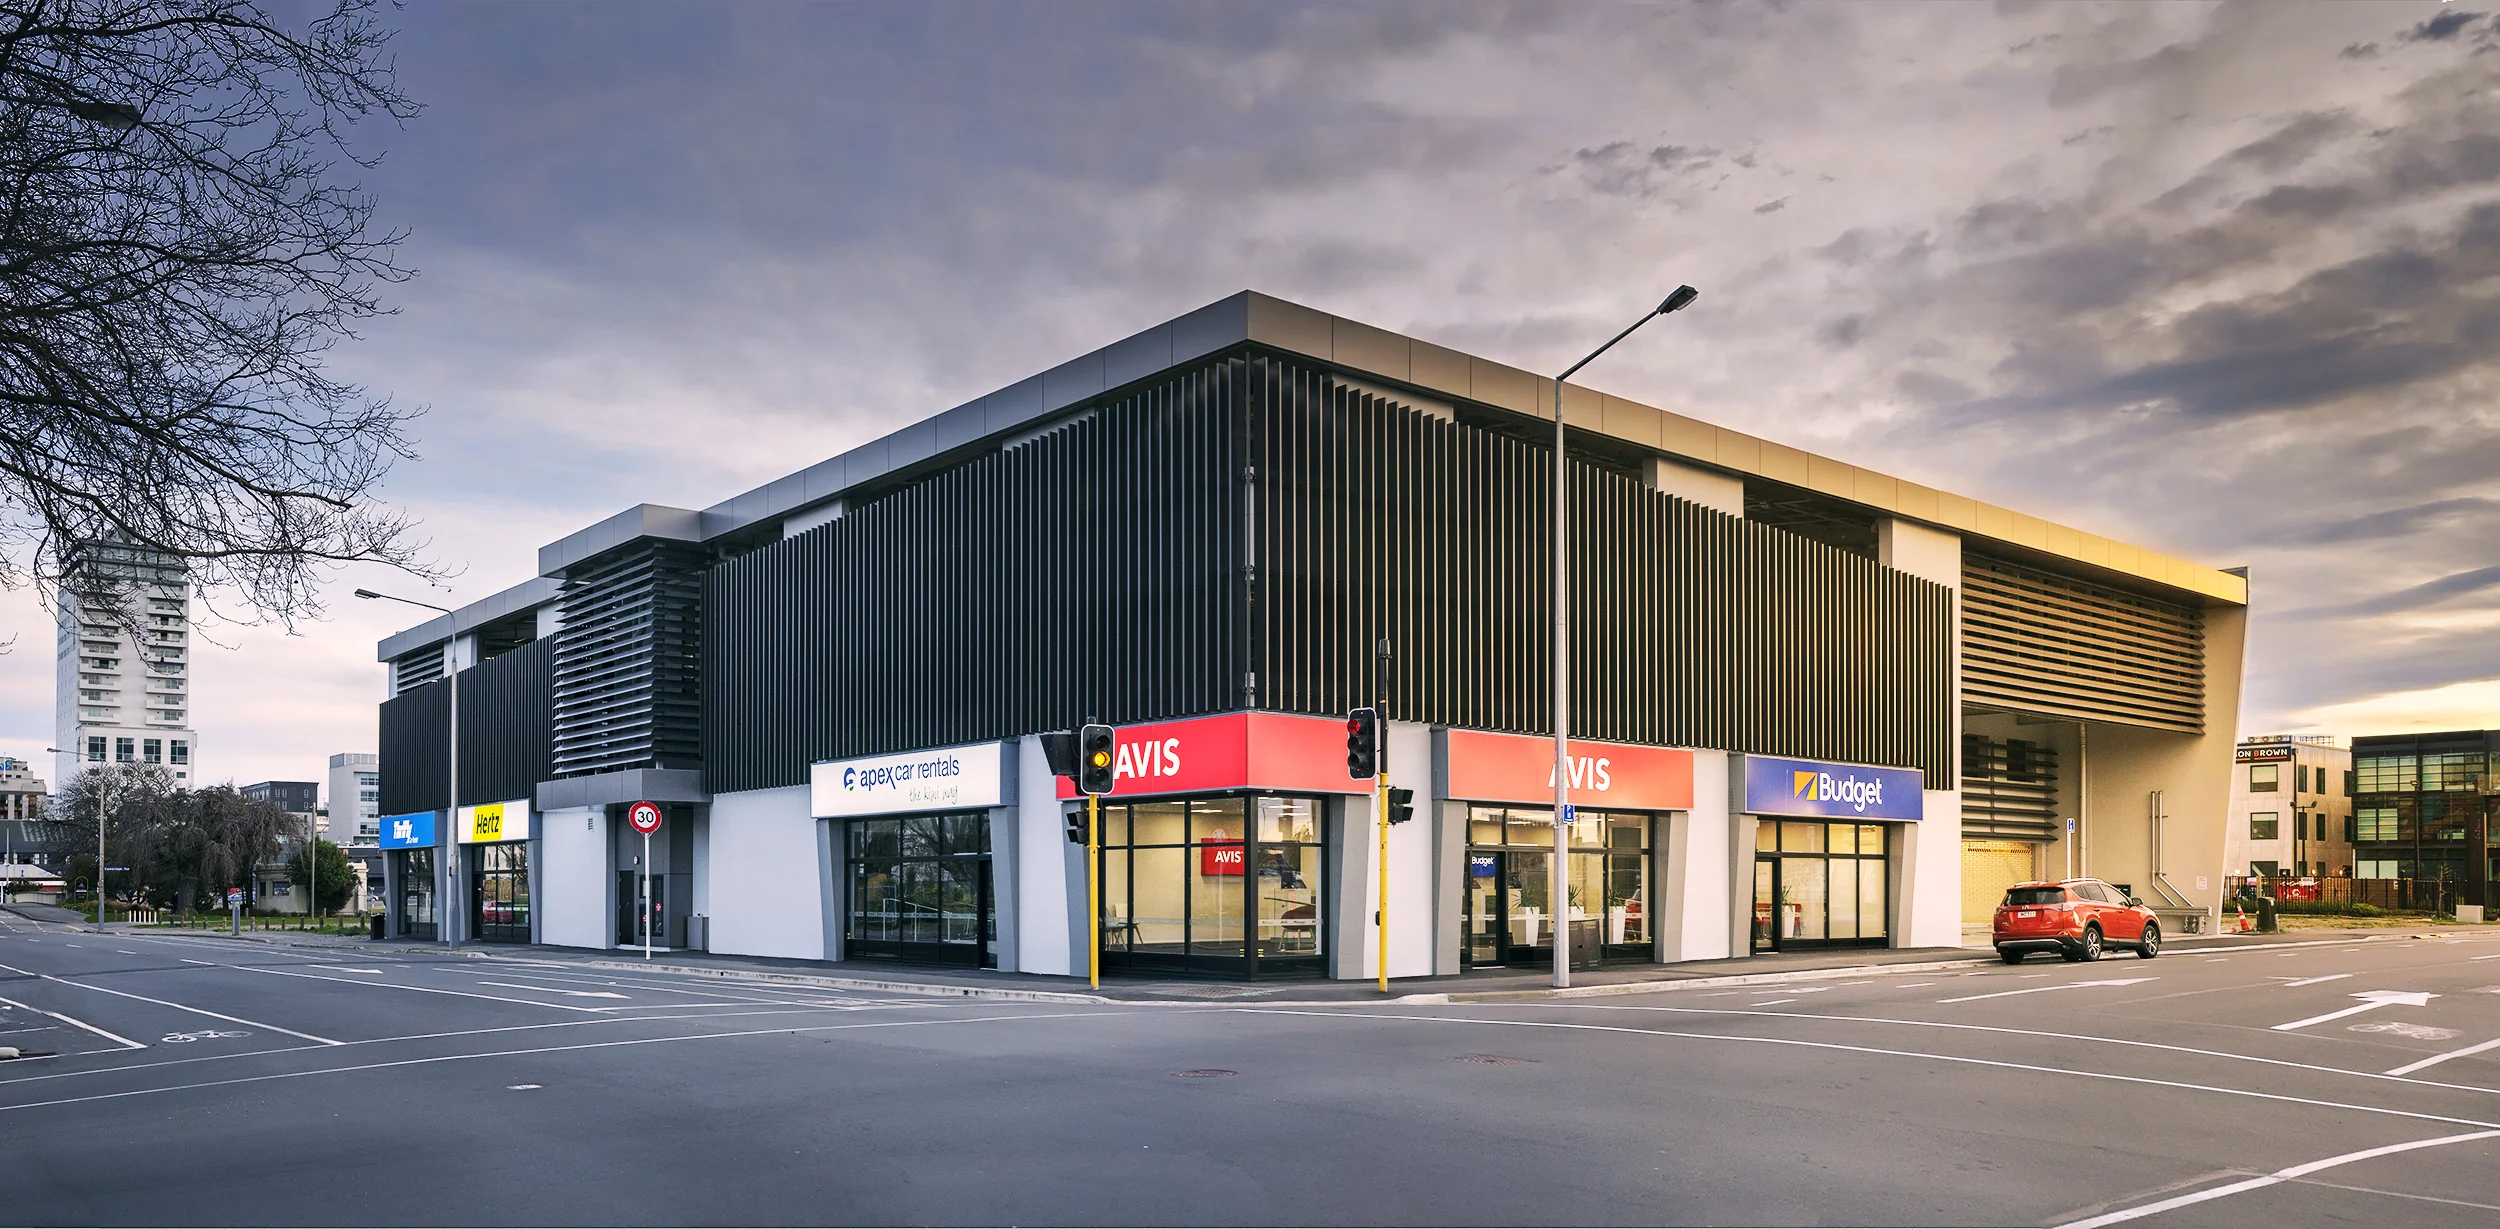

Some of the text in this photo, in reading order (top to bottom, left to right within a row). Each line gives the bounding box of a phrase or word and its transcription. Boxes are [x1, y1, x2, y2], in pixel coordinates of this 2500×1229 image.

[1114, 738, 1181, 779] AVIS
[2236, 748, 2288, 758] ON BROWN
[860, 755, 960, 791] apex car rentals
[909, 788, 921, 801] the
[1819, 772, 1883, 813] Budget
[476, 813, 500, 834] Hertz
[637, 811, 654, 823] 30
[1214, 850, 1242, 864] AVIS
[1472, 856, 1494, 867] Budget
